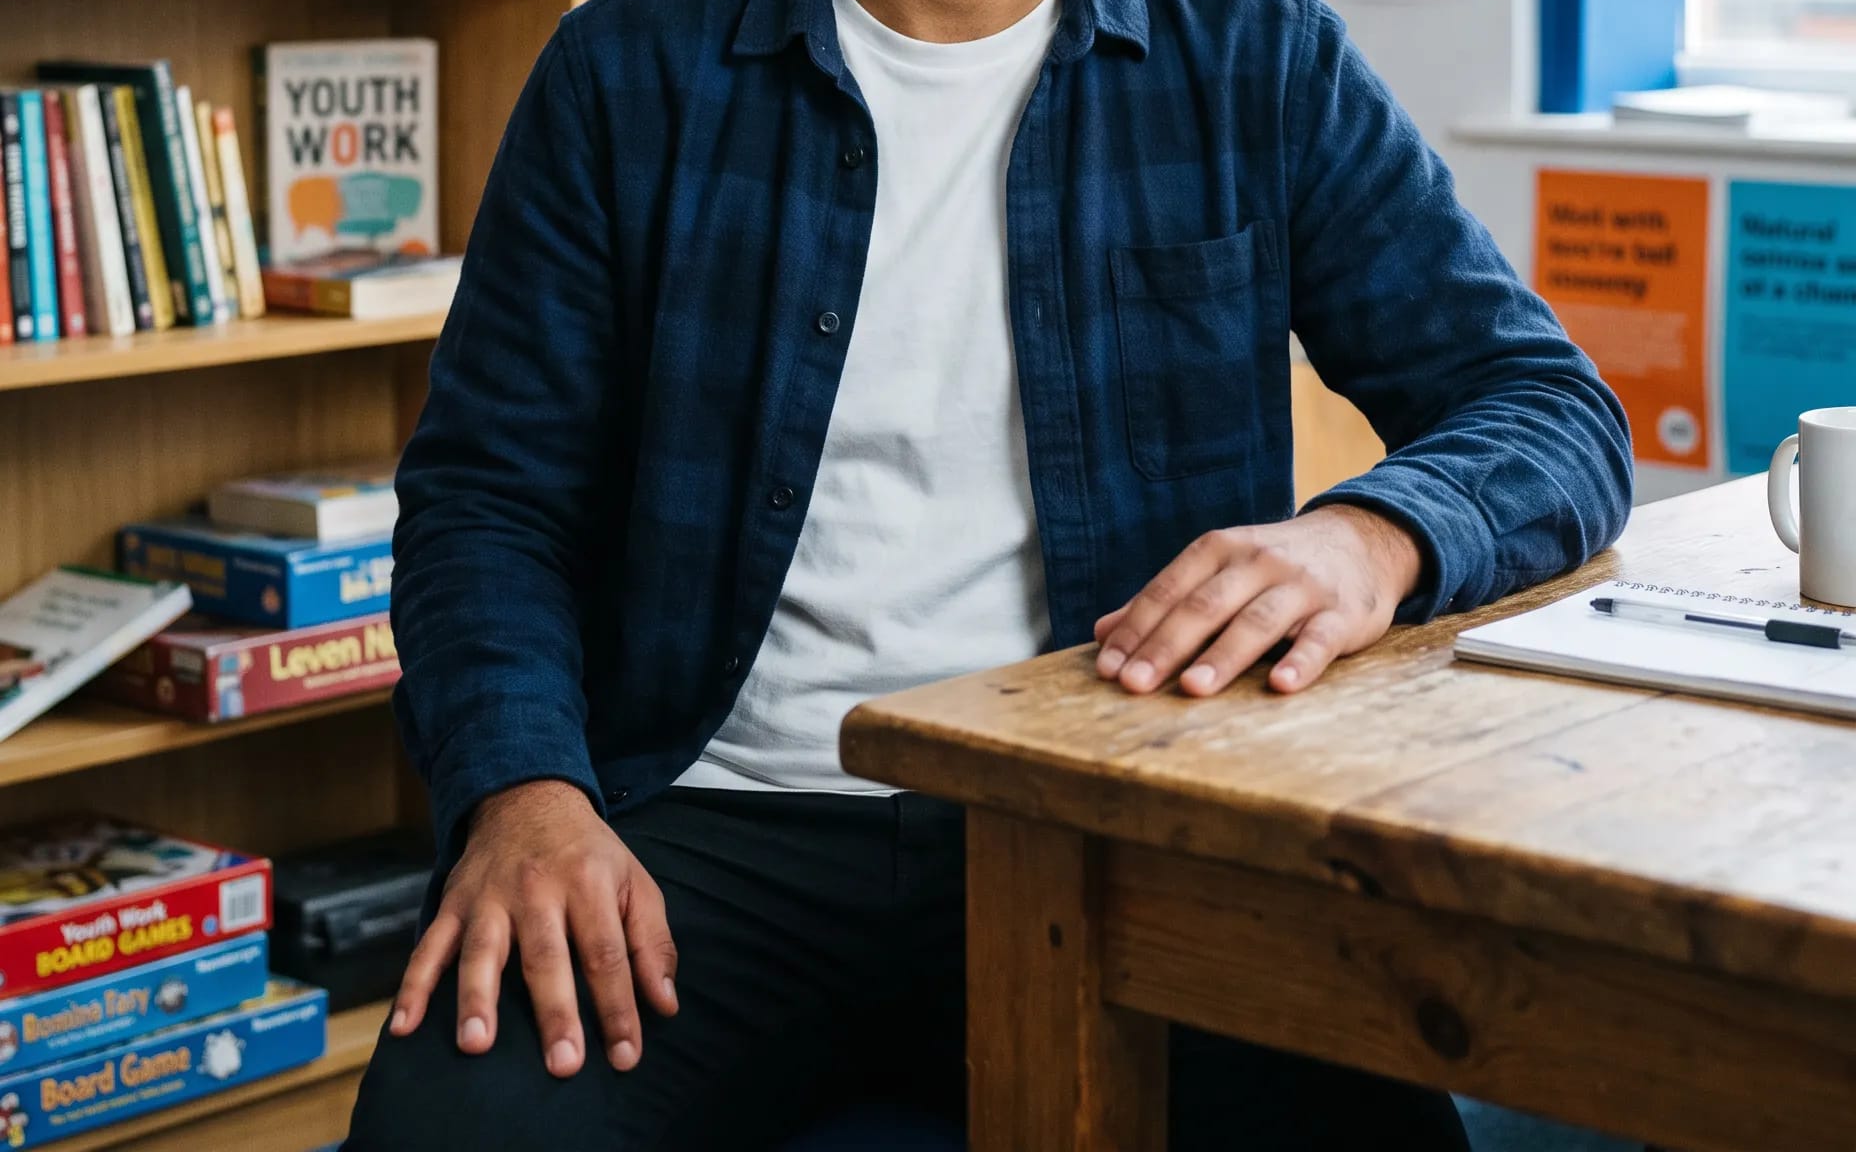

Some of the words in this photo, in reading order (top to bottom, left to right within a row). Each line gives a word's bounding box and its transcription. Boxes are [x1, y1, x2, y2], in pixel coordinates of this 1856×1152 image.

[284, 76, 419, 118] YOUTH
[285, 120, 420, 166] WORK
[60, 912, 117, 945] Youth
[118, 899, 167, 929] Work
[36, 935, 115, 977] BOARD
[117, 914, 193, 955] GAMES
[40, 1060, 115, 1112] Board
[120, 1047, 191, 1086] Game
